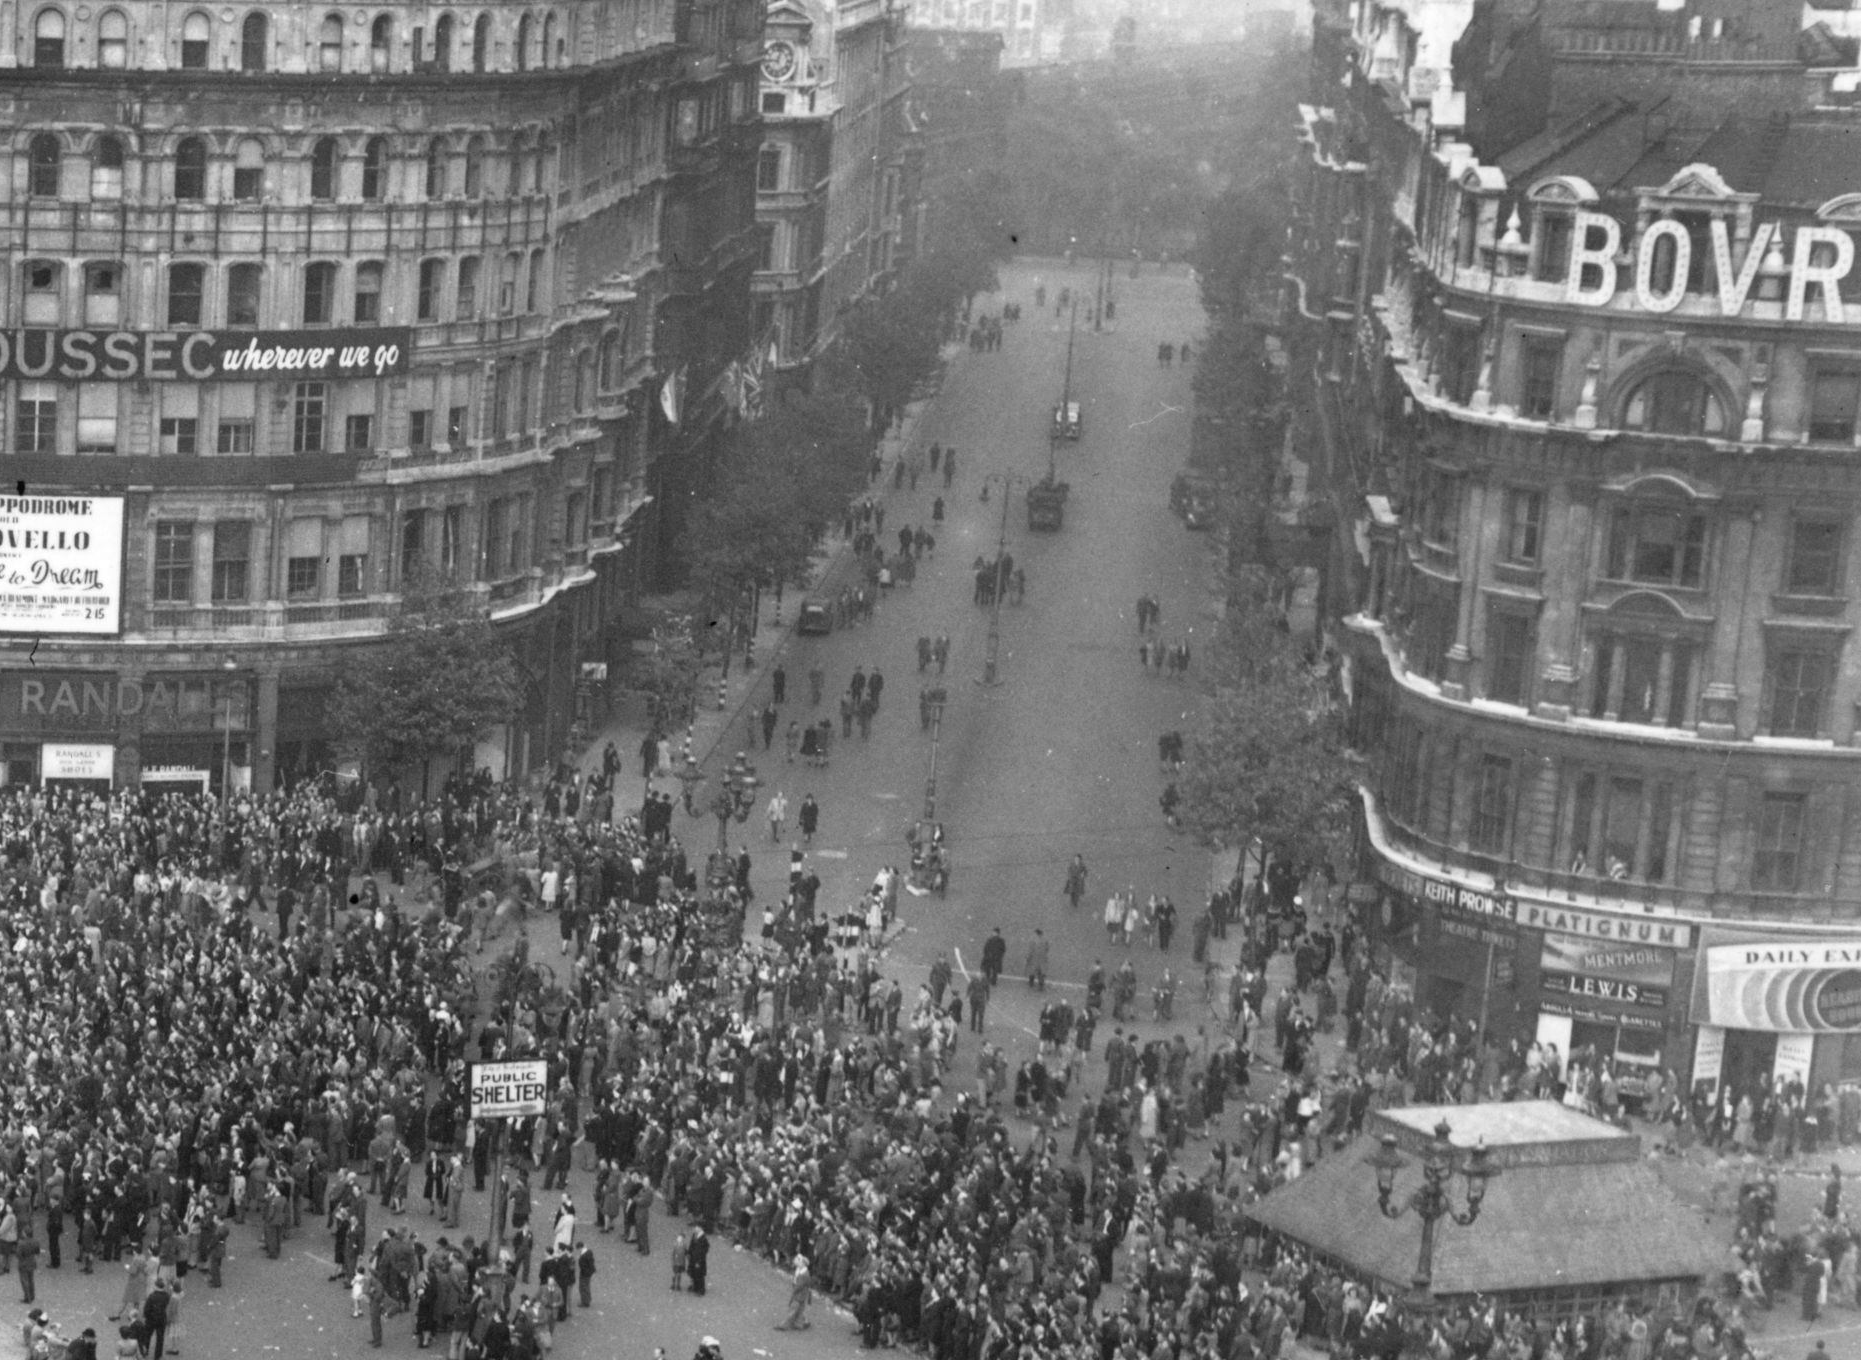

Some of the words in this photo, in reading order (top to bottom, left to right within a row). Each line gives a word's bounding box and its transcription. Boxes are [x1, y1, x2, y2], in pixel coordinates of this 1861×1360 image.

[1566, 210, 1856, 323] BOVR
[223, 337, 335, 370] wherever
[339, 345, 370, 367] we
[374, 344, 399, 375] go
[9, 569, 26, 585] to
[30, 559, 104, 590] Dream
[1424, 879, 1456, 906] KEITH
[1458, 890, 1514, 919] PROWSE
[1529, 907, 1676, 943] PLATIGNUM
[1584, 949, 1663, 969] MENTMORE
[1745, 950, 1813, 964] DAILY
[1568, 975, 1638, 1002] LEWIS
[481, 1072, 537, 1084] PUBLIC
[472, 1083, 545, 1105] SHELTER
